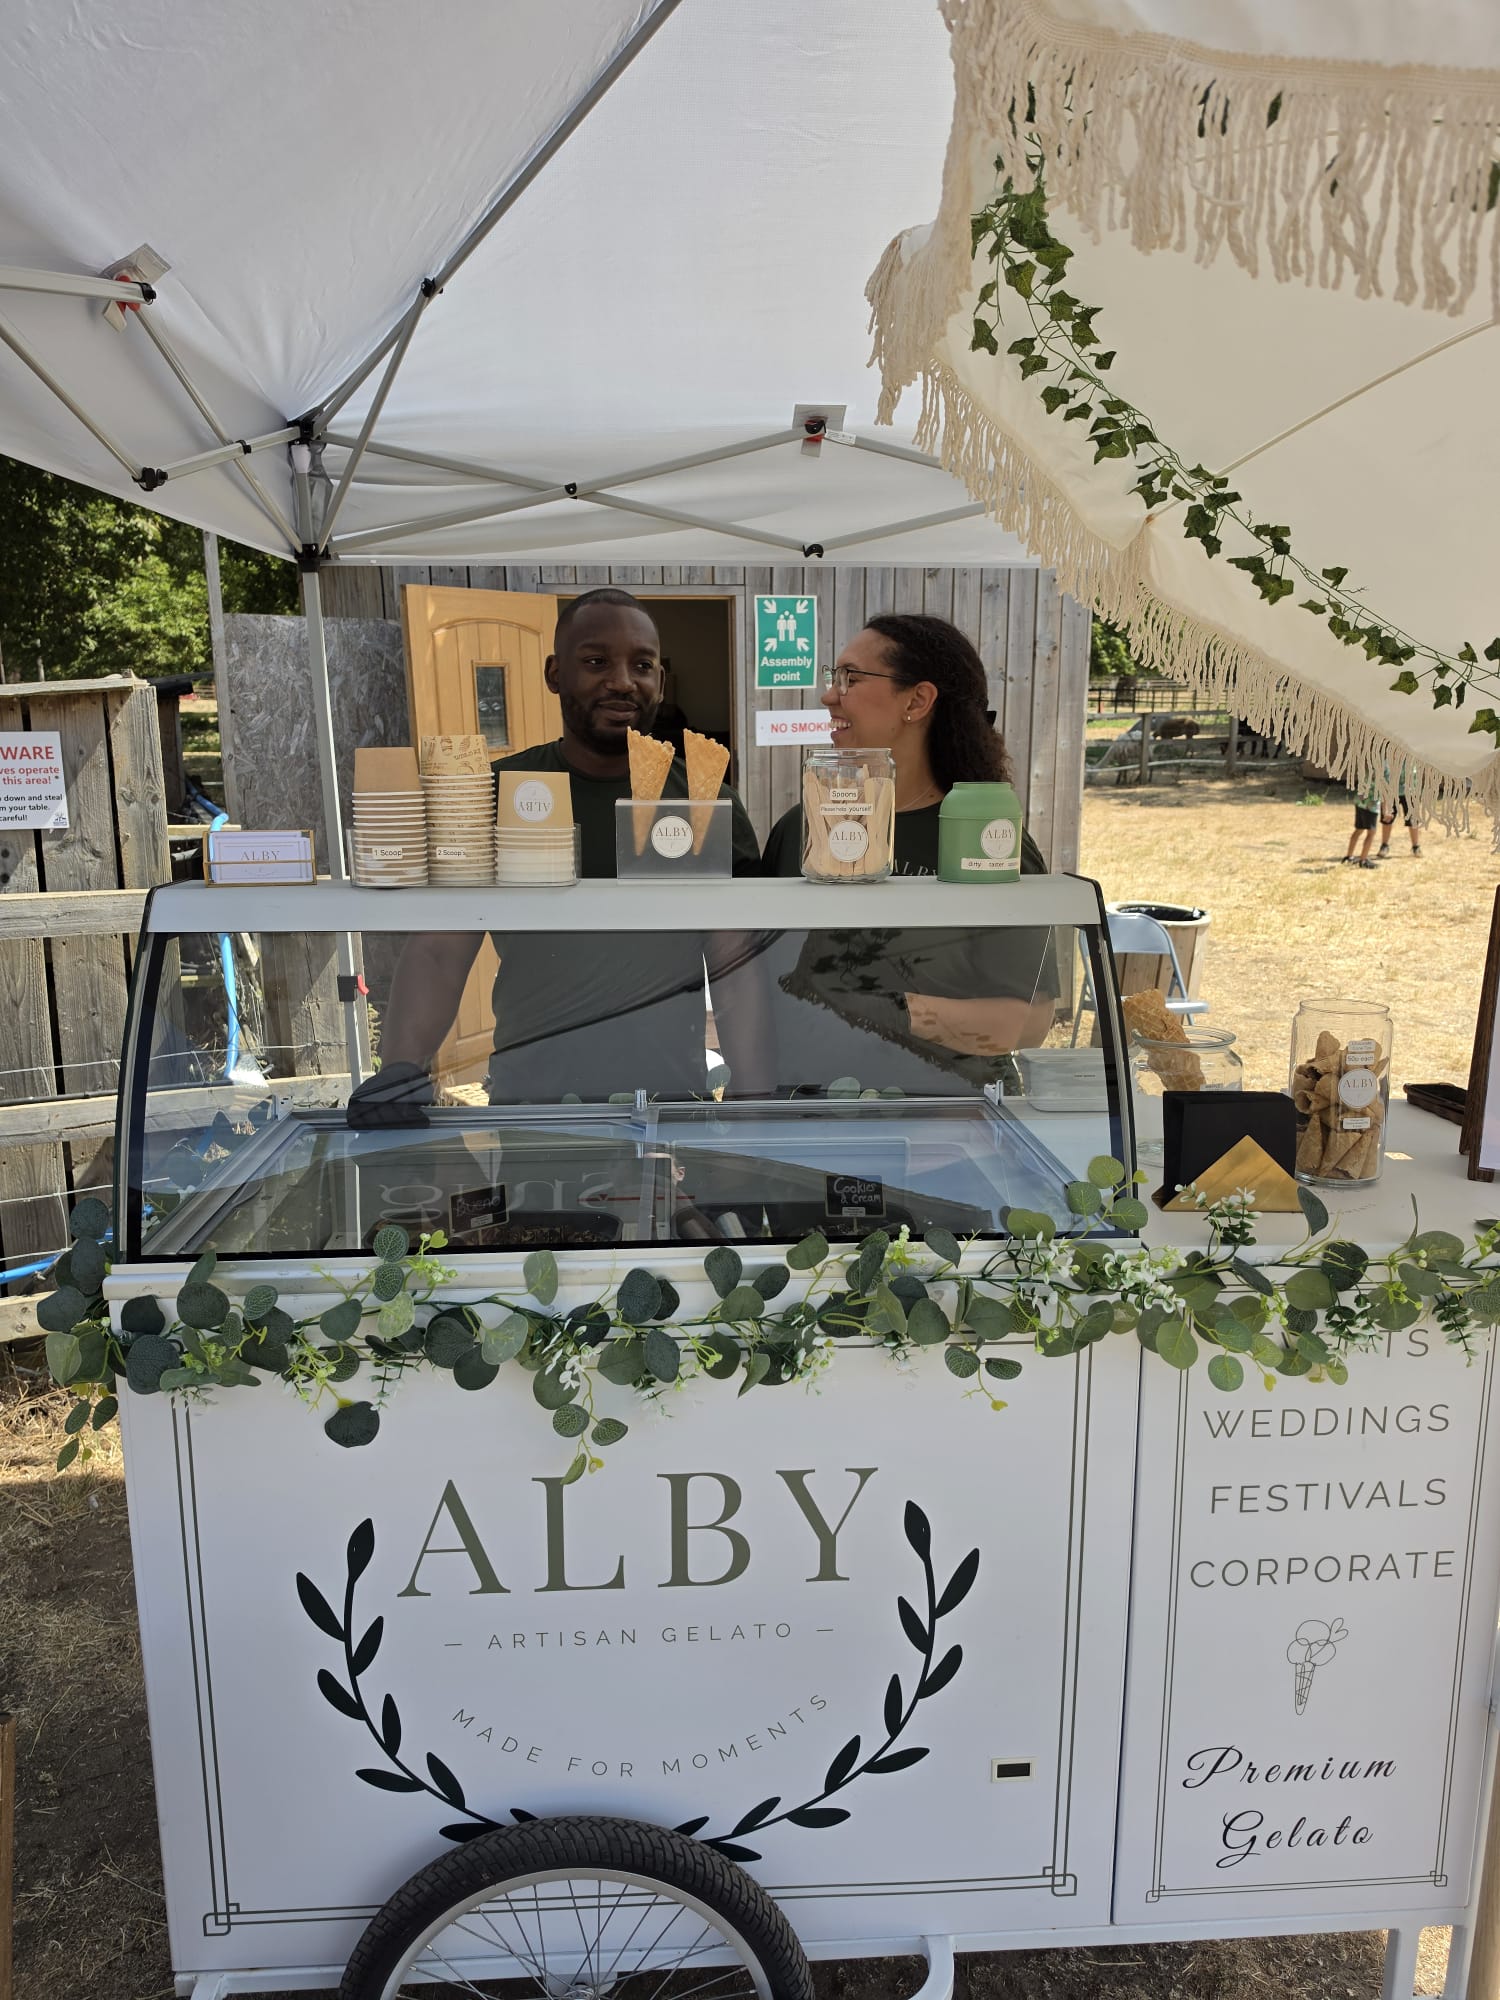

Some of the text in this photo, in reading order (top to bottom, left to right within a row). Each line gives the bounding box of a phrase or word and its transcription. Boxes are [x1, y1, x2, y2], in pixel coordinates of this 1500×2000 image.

[760, 656, 813, 669] Assembly
[773, 671, 801, 684] point
[770, 723, 788, 734] NO
[18, 766, 60, 776] operate
[3, 776, 52, 785] this area!
[27, 793, 43, 801] and
[44, 793, 63, 801] steal
[832, 790, 857, 798] Spoons
[519, 801, 551, 812] ALBY
[848, 805, 872, 813] yourself
[655, 827, 689, 837] ALBY
[832, 831, 865, 841] ALBY
[985, 828, 1013, 839] ALBY
[241, 850, 280, 861] ALBY
[380, 849, 402, 857] Scoop
[1343, 1079, 1374, 1089] ALBY
[833, 1177, 877, 1194] Cookies
[1203, 1404, 1450, 1439] WEDDINGS
[1210, 1478, 1447, 1514] FESTIVALS
[397, 1467, 878, 1598] ALBY
[1190, 1551, 1455, 1588] CORPORATE
[488, 1622, 791, 1650] ARTISAN GELATO
[452, 1694, 827, 1777] MADE FOR MOMENTS
[1182, 1744, 1398, 1789] Premium
[1215, 1810, 1374, 1868] Gelato
